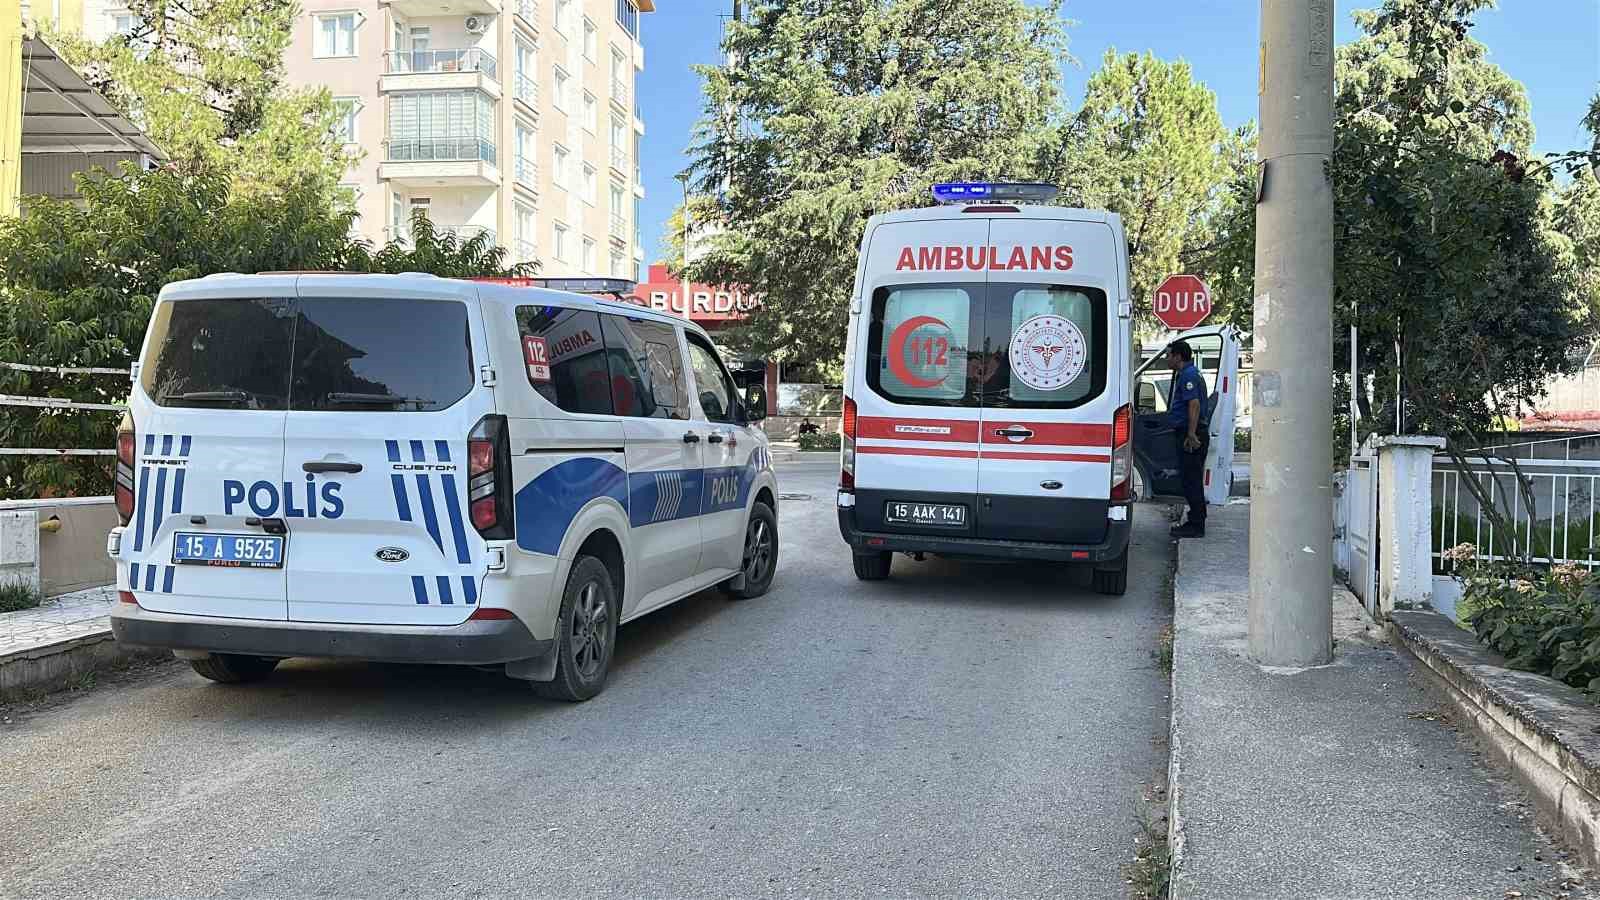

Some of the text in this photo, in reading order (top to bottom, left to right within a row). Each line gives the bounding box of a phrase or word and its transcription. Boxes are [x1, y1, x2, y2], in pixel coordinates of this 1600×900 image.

[896, 246, 1074, 271] AMBULANS
[1159, 292, 1205, 312] DUR
[528, 340, 546, 362] 112
[912, 336, 948, 366] 112
[223, 472, 344, 519] POLİS
[895, 505, 960, 521] 15 AAK 141
[186, 536, 203, 557] 15
[214, 537, 223, 558] A
[234, 538, 275, 560] 9525
[380, 549, 404, 561] Ford
